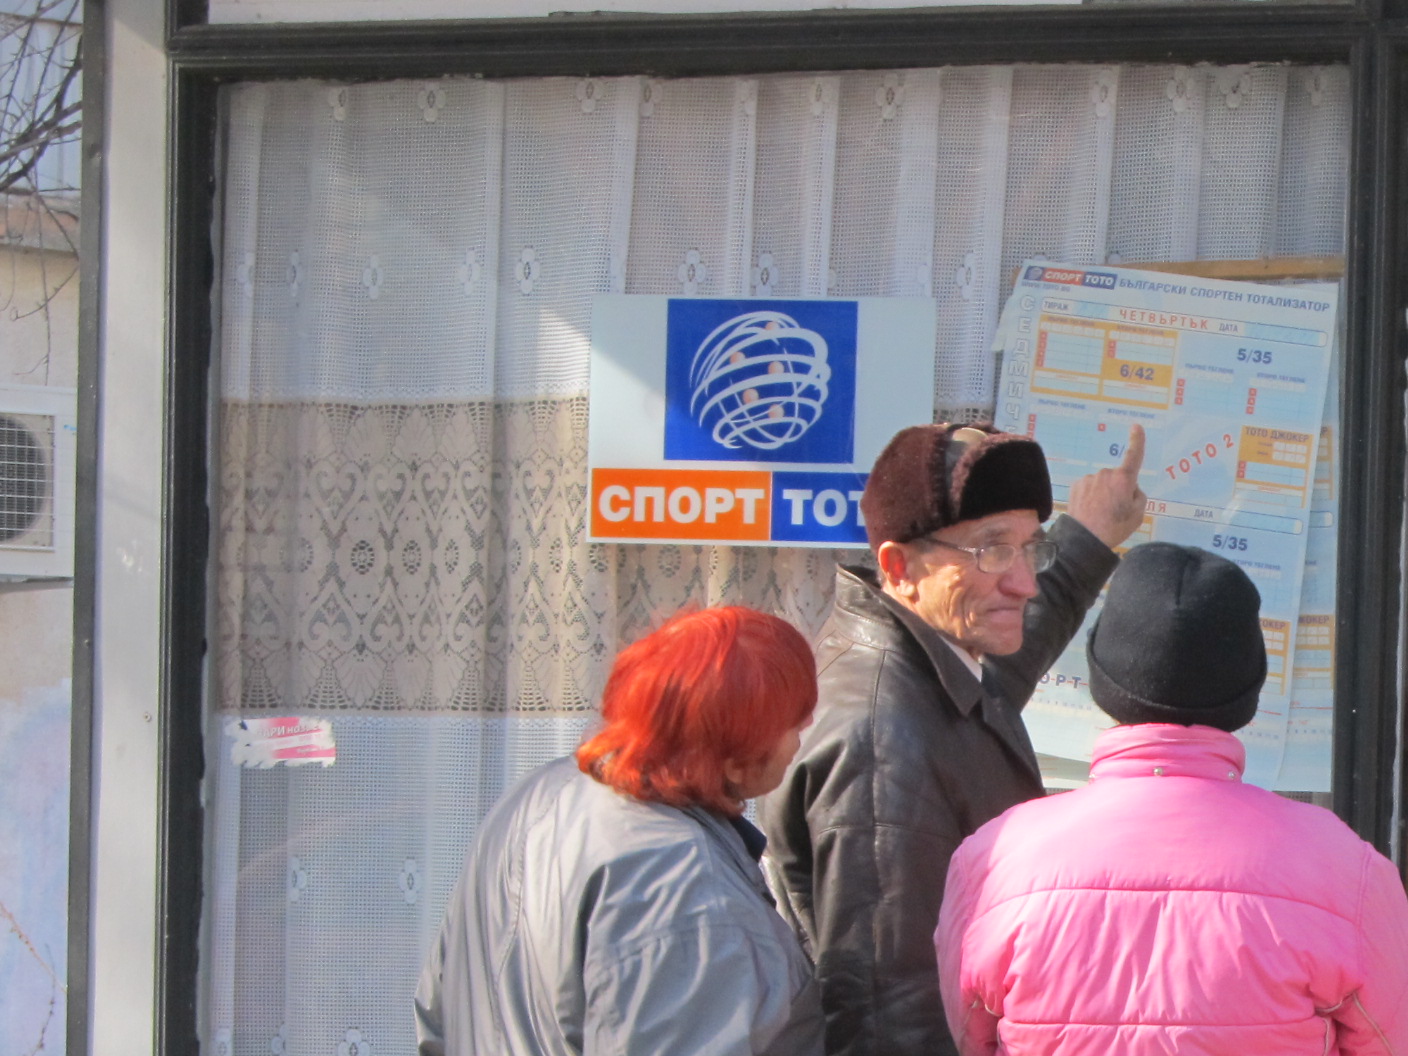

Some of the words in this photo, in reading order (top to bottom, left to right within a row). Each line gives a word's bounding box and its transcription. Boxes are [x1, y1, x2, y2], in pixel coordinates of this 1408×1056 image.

[1043, 270, 1083, 282] СПОРТ
[1084, 274, 1115, 286] ТОТО
[1119, 278, 1187, 295] БЪЛГАРСКИ
[1190, 286, 1243, 302] СПОРТЕН
[1247, 293, 1331, 312] ТОТАЛИЗАТОР
[1219, 323, 1239, 333] ДАТА
[1236, 348, 1273, 365] 5/35
[1119, 364, 1155, 381] 6/42
[1246, 426, 1268, 438] ТОТО
[1109, 443, 1126, 459] 6/
[1165, 443, 1218, 480] ТОТО
[1223, 434, 1235, 449] 2
[599, 485, 765, 525] СПОРТ
[782, 488, 867, 528] ТОТ
[1193, 508, 1214, 519] ДАТА
[1212, 534, 1248, 551] 5/35
[1261, 619, 1287, 630] ОКЕР
